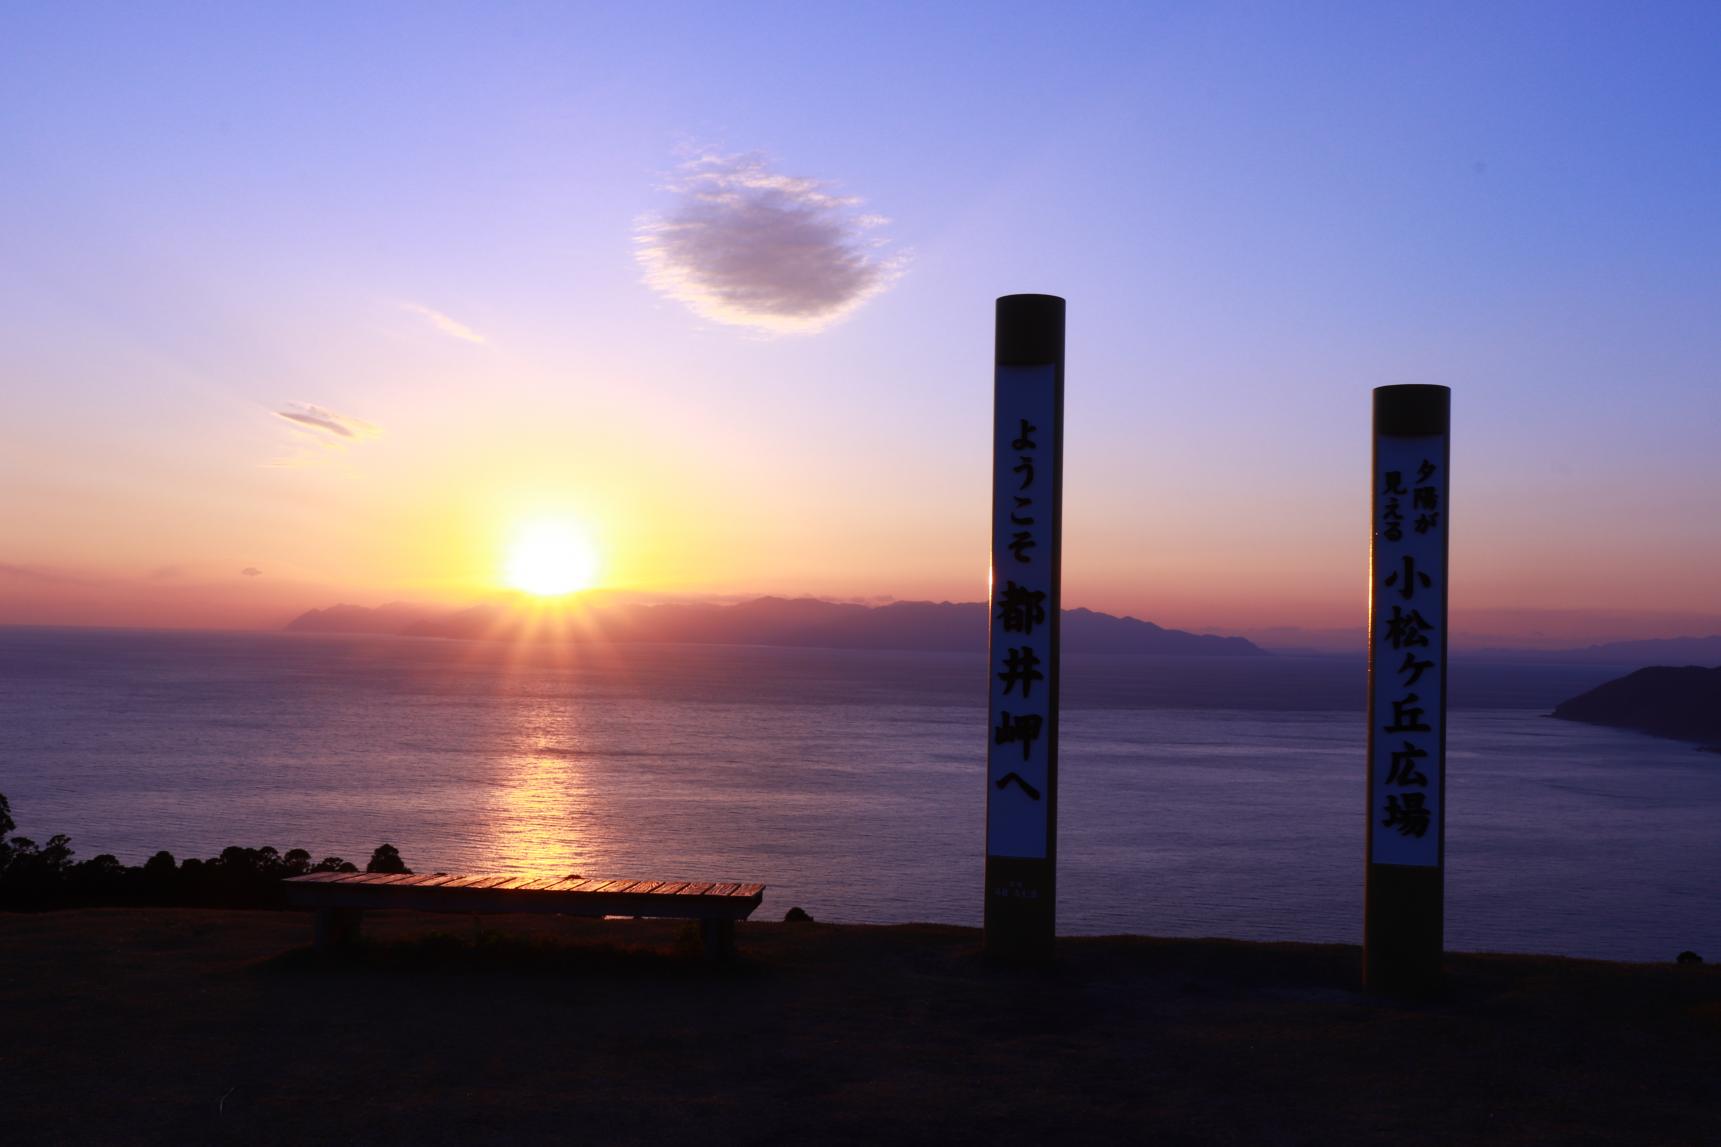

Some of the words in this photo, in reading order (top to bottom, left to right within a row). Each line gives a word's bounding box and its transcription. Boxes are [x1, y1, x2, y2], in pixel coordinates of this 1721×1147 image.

[1384, 471, 1408, 541] 見える
[1413, 459, 1439, 534] 夕陽が
